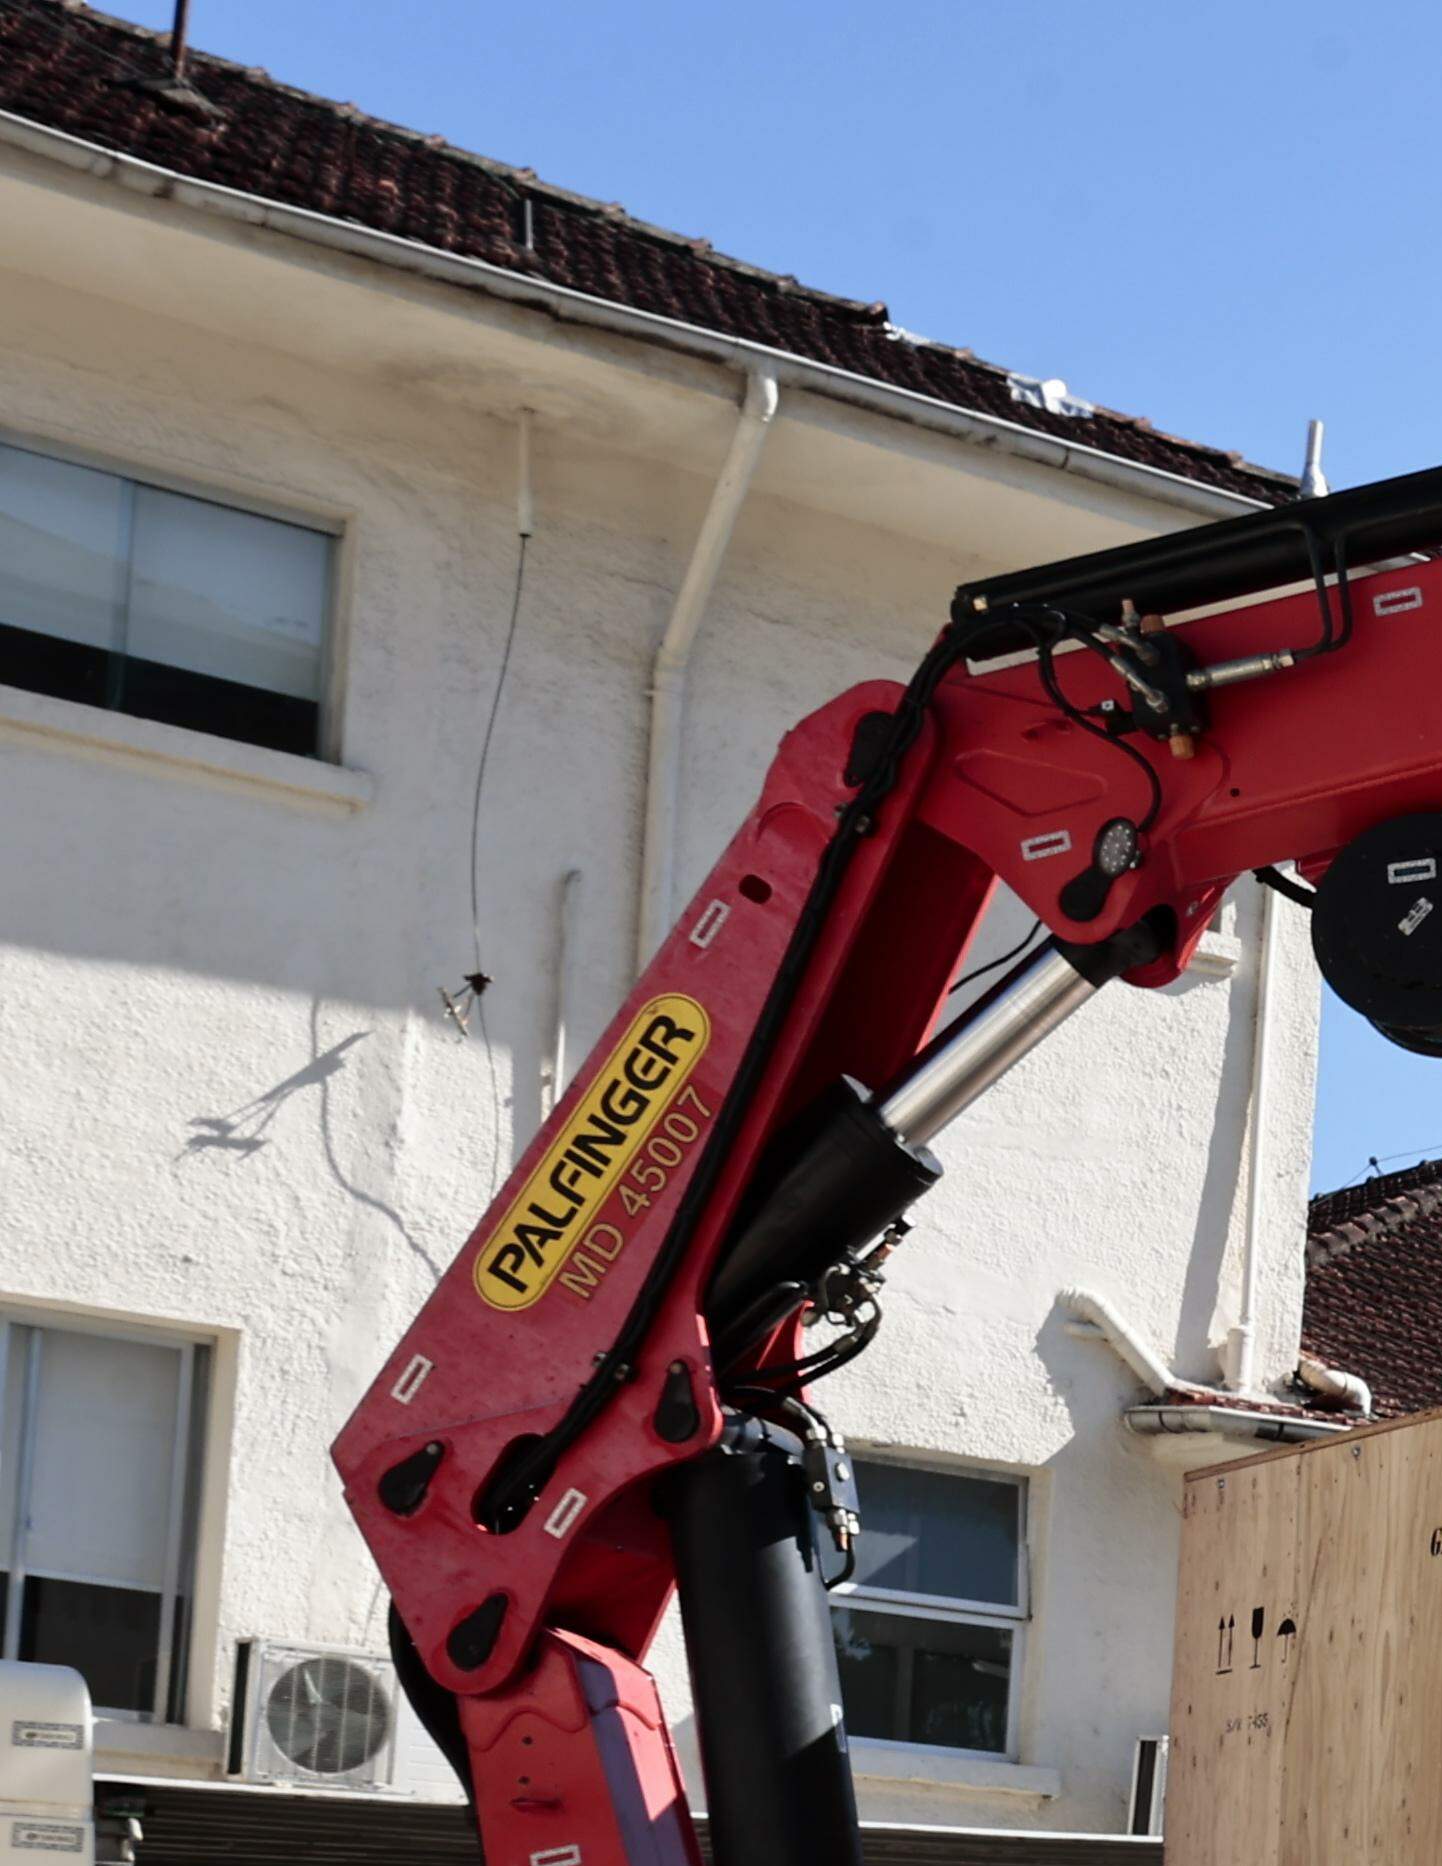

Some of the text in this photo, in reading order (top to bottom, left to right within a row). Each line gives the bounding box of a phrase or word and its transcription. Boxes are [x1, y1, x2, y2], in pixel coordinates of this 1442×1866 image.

[487, 1013, 695, 1294] PALFINGER
[559, 1084, 712, 1299] MD 45007
